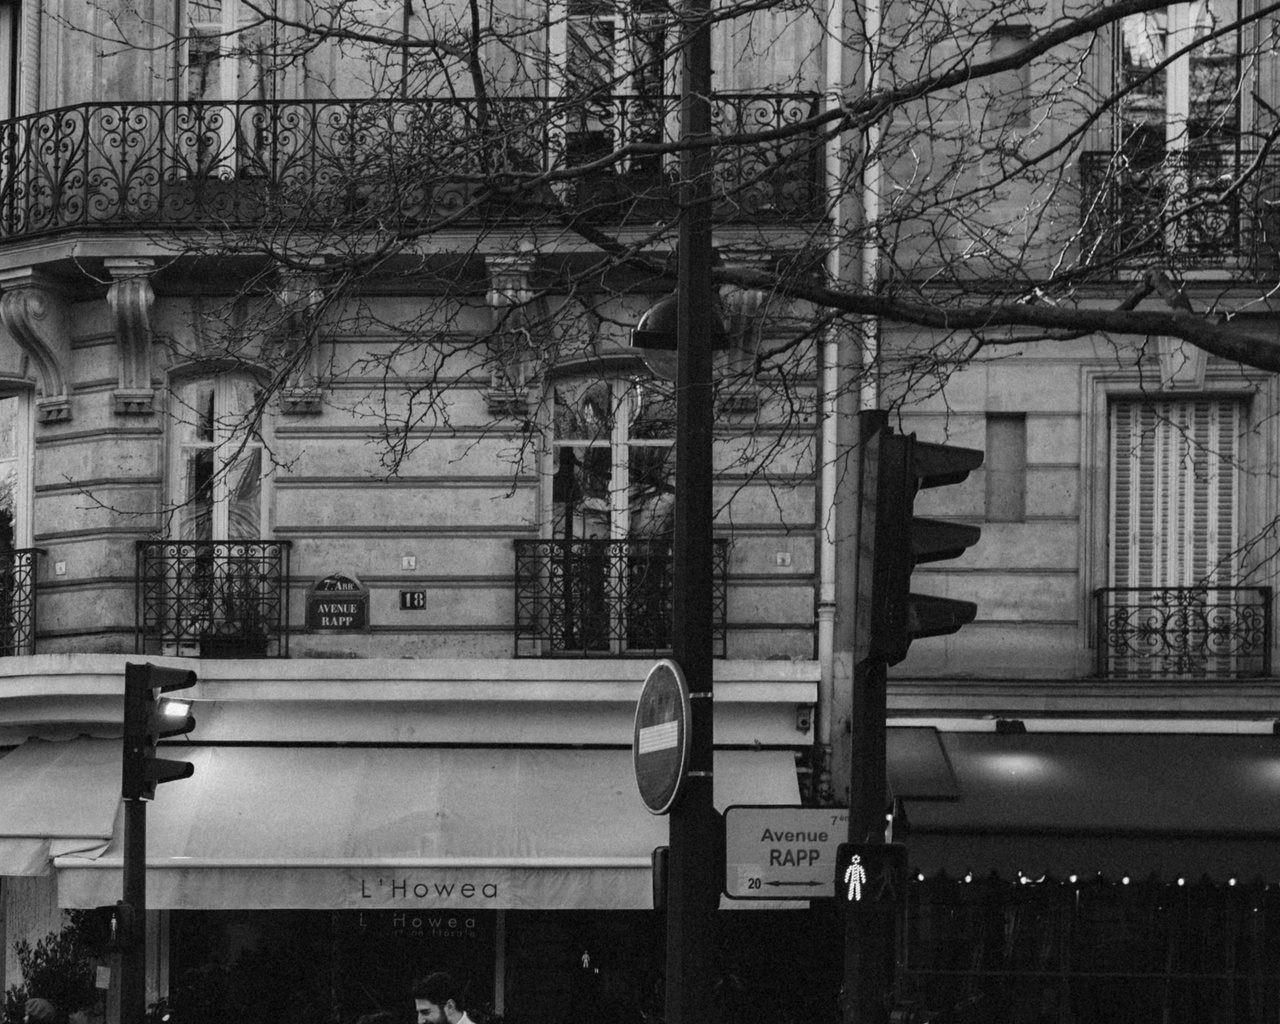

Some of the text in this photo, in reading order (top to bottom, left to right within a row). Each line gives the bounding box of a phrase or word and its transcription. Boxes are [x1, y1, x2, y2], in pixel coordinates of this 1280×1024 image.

[405, 592, 424, 607] 18
[318, 604, 357, 614] AVENUE
[322, 616, 353, 626] RAPP
[760, 828, 828, 842] Avenue
[769, 849, 820, 867] RAPP
[361, 879, 497, 899] L'Howea
[747, 878, 761, 889] 20
